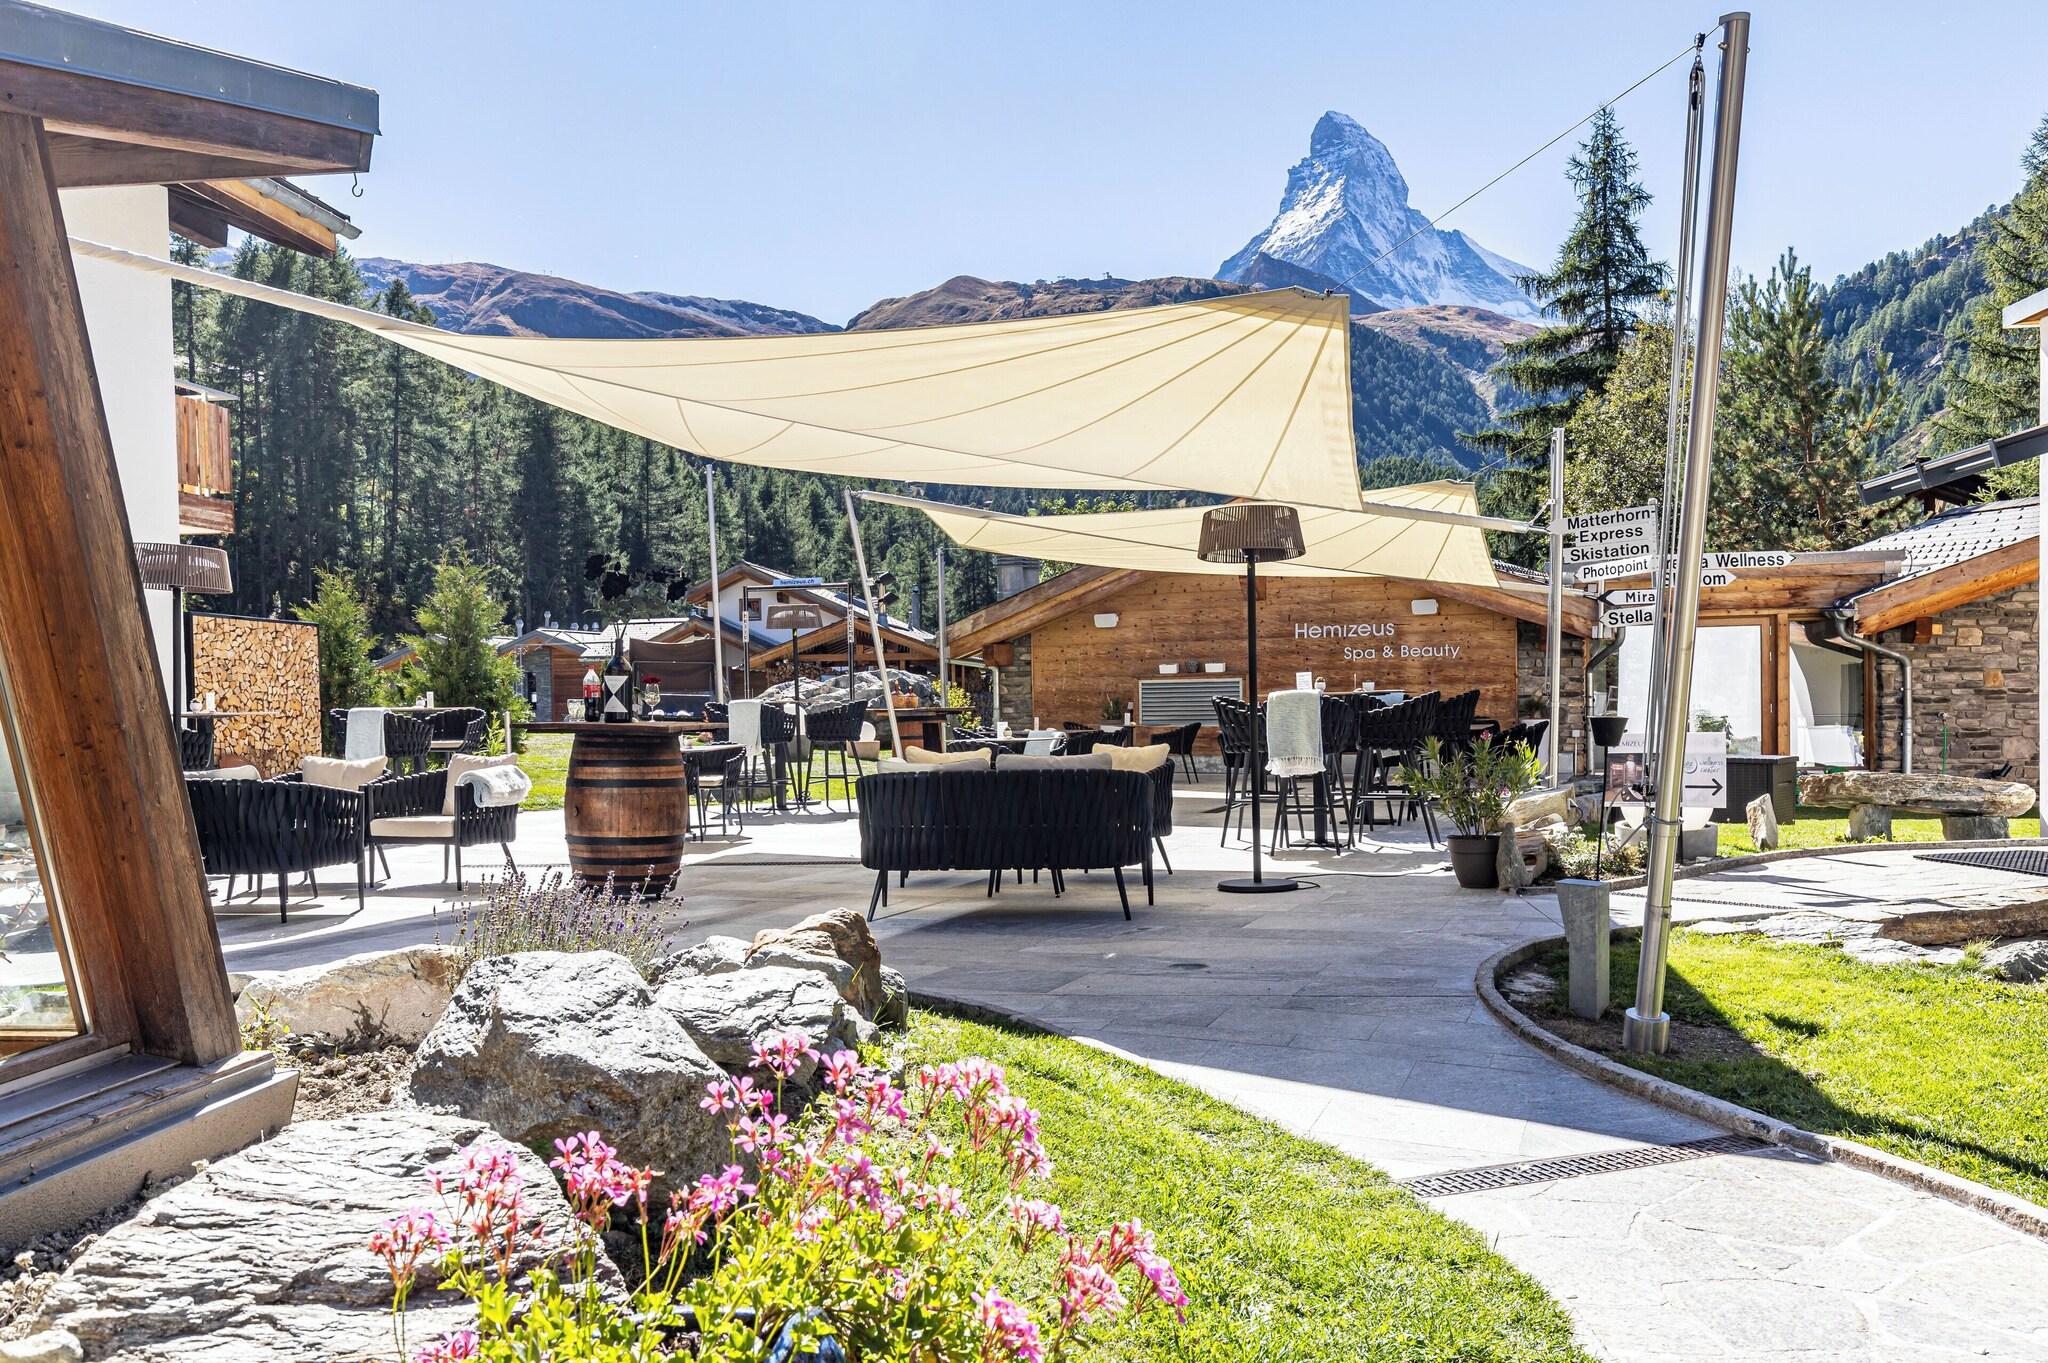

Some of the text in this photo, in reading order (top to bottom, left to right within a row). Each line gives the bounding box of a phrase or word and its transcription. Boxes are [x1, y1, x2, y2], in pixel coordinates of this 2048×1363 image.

[1568, 510, 1655, 530] Matterhorn-
[1570, 544, 1650, 562] Skistation
[1716, 554, 1784, 568] Wellness
[1583, 559, 1648, 579] Photopoint
[1626, 592, 1655, 602] Mira
[1608, 610, 1652, 625] Stella
[1294, 622, 1394, 638] Hemizeus
[1344, 644, 1460, 661] Spa & Beauty
